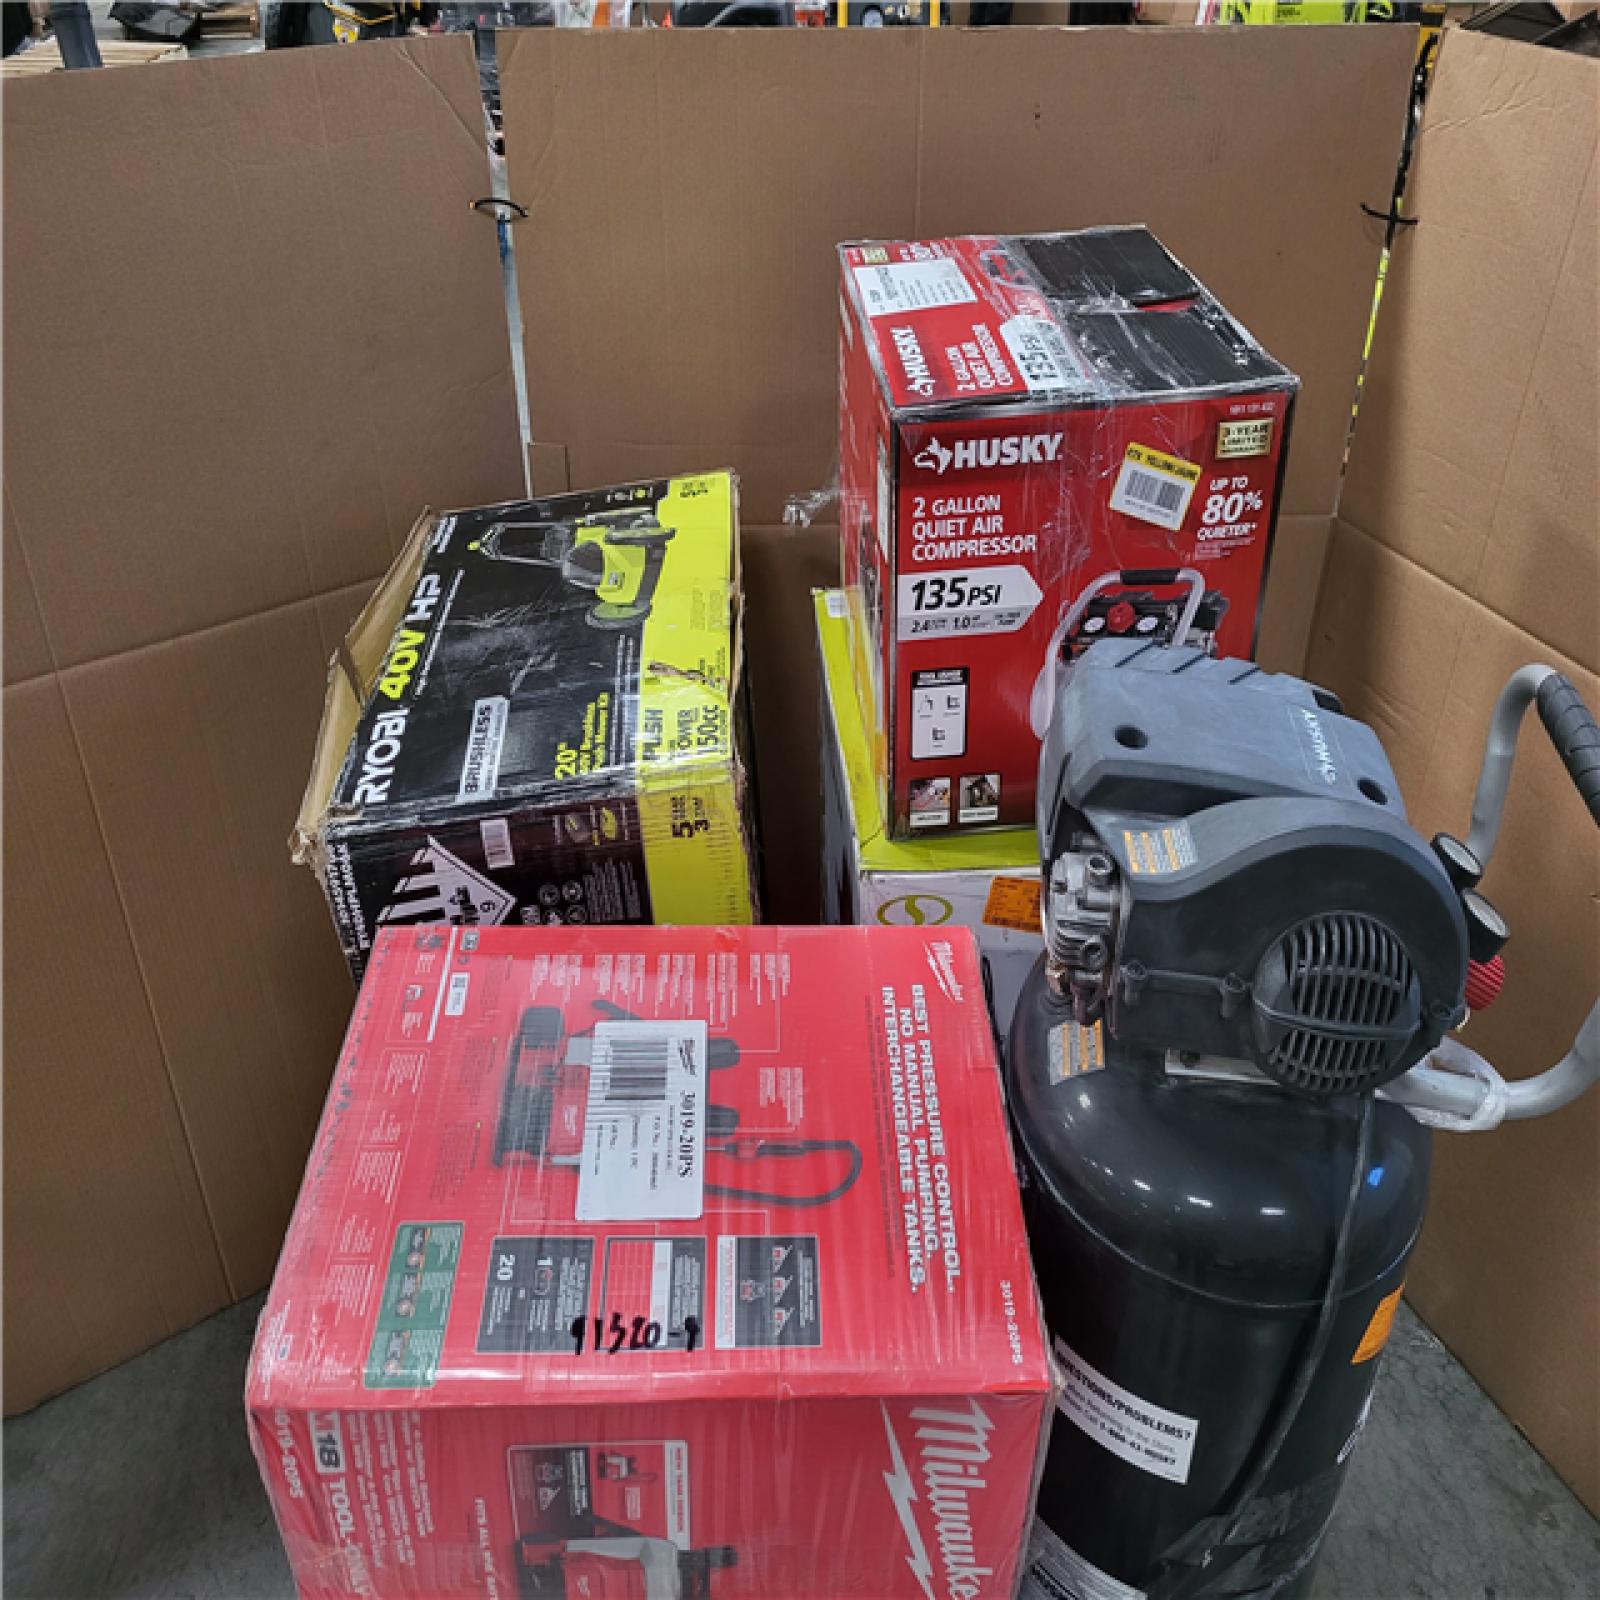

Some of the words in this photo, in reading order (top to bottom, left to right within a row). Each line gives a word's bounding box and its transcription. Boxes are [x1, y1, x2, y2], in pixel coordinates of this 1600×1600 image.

[891, 327, 930, 377] HUSKY
[954, 432, 1063, 469] HUSKY
[912, 496, 925, 518] 2
[932, 494, 1001, 516] GALLON
[1202, 489, 1263, 524] 80%
[1231, 475, 1248, 490] TO
[912, 517, 967, 542] QUIET
[972, 514, 1004, 536] AIR
[912, 534, 1038, 561] COMPRESSOR
[406, 573, 441, 622] HP
[911, 576, 968, 611] 135
[967, 584, 1002, 606] PSI
[379, 628, 426, 700] 40V
[354, 705, 409, 804] RYOBI
[464, 702, 492, 794] BRUSHLESS
[899, 1007, 914, 1037] NO
[911, 984, 930, 1033] BEST
[903, 1042, 922, 1131] MANUAL
[919, 1038, 945, 1164] PRESSURE
[679, 1090, 697, 1179] 3019-20PS
[881, 986, 916, 1195] INTERCHANGEABLE
[902, 1202, 926, 1294] TANKS.
[913, 1137, 940, 1259] PUMPING.
[932, 1163, 961, 1294] CONTROL.
[496, 1254, 516, 1282] 20
[1000, 1279, 1023, 1366] 3019-20PS
